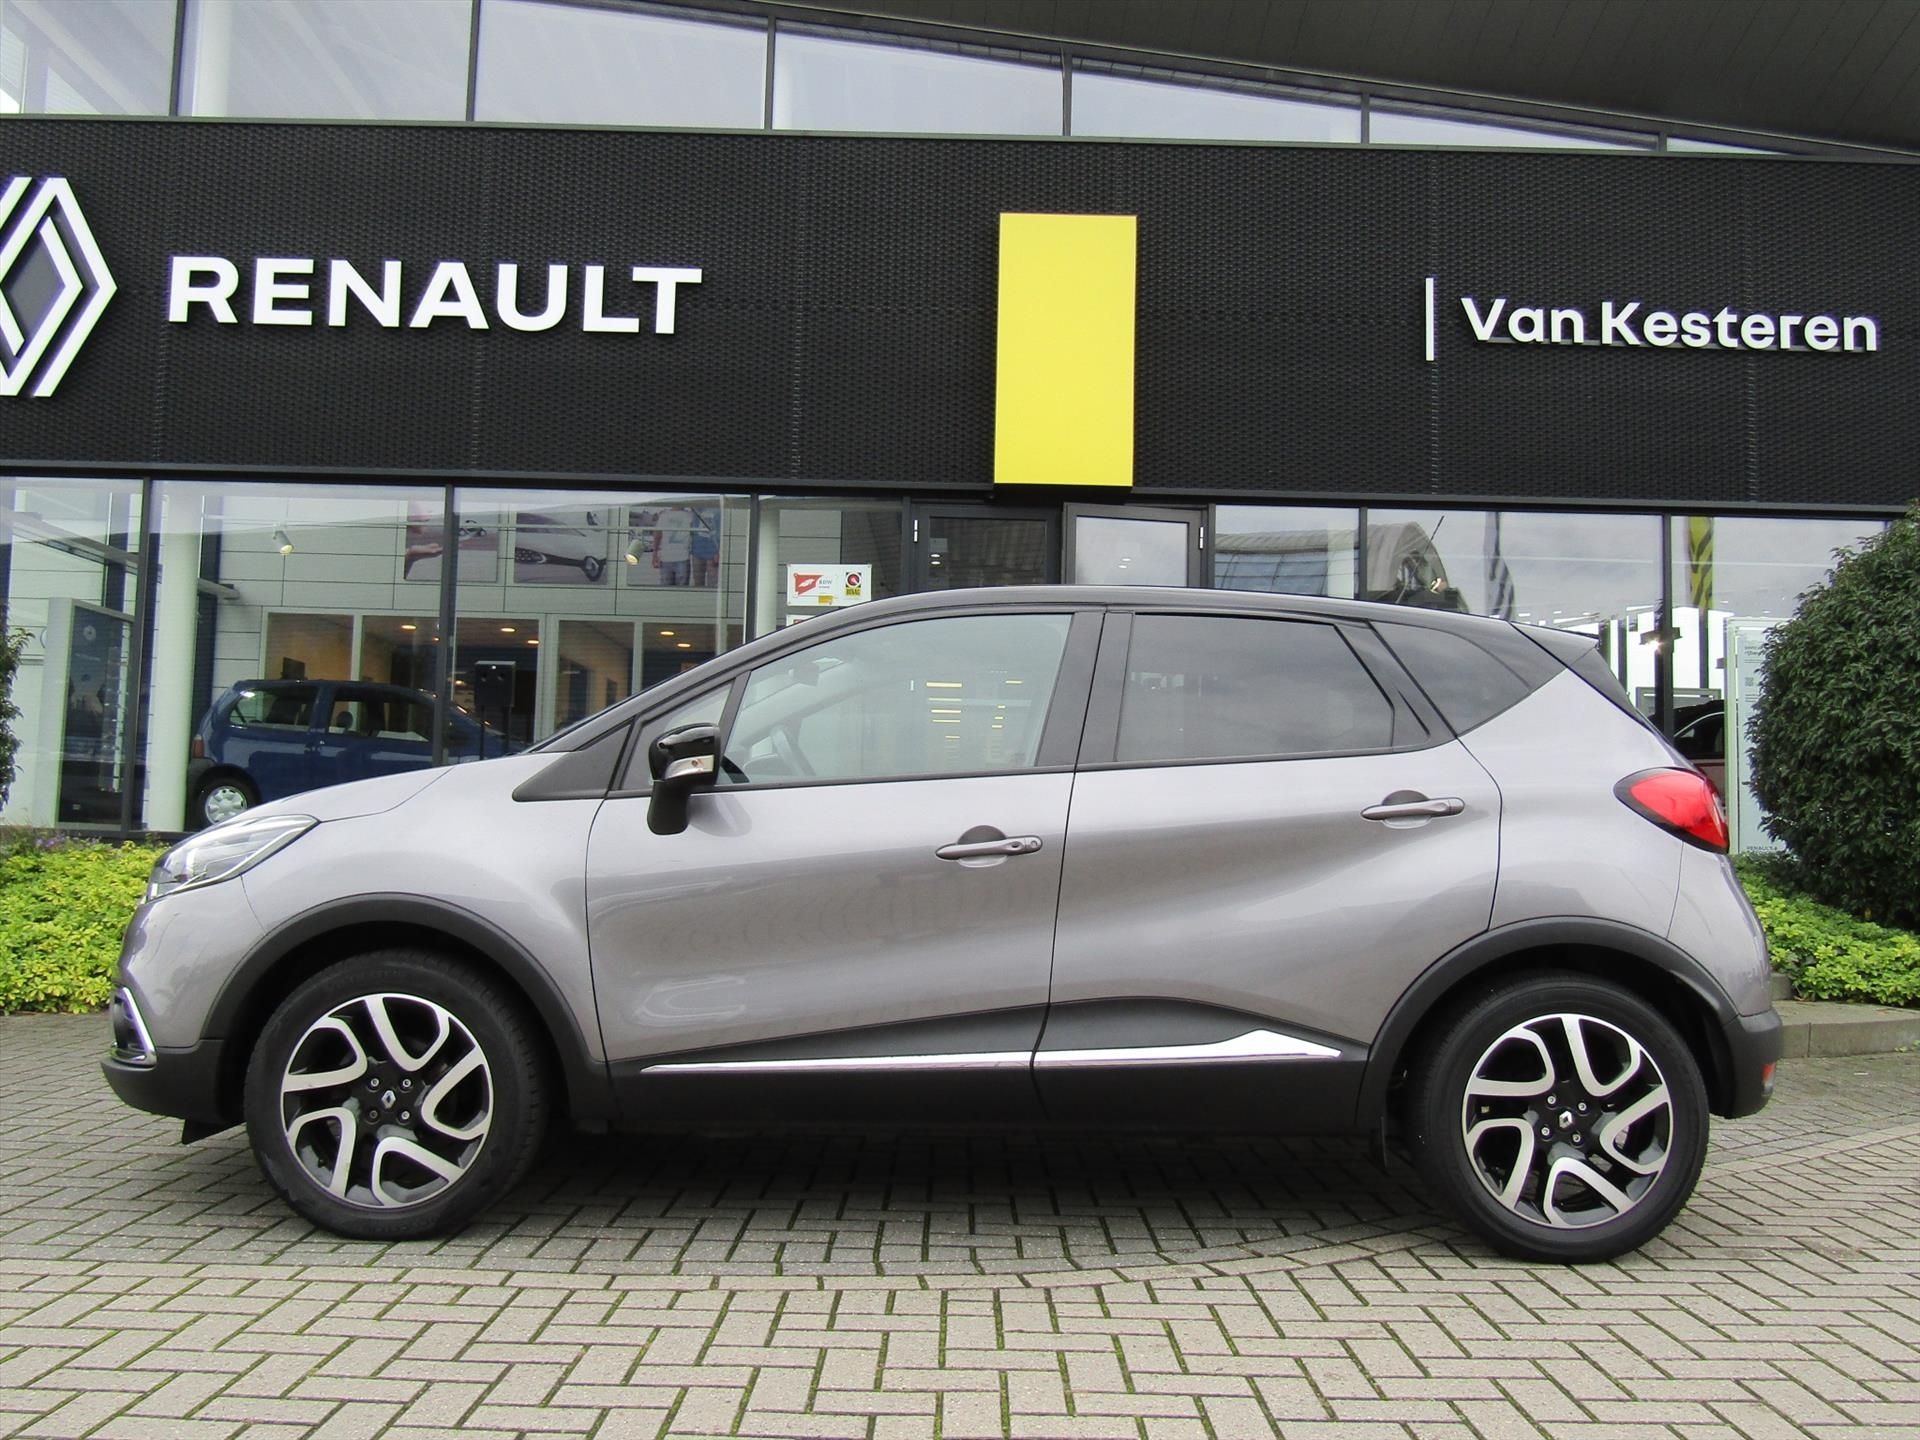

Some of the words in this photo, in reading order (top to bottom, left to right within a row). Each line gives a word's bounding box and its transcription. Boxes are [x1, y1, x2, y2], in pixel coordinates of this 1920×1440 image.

[168, 256, 703, 335] RENAULT
[1460, 297, 1585, 344] Van
[1601, 301, 1877, 352] Kesteren
